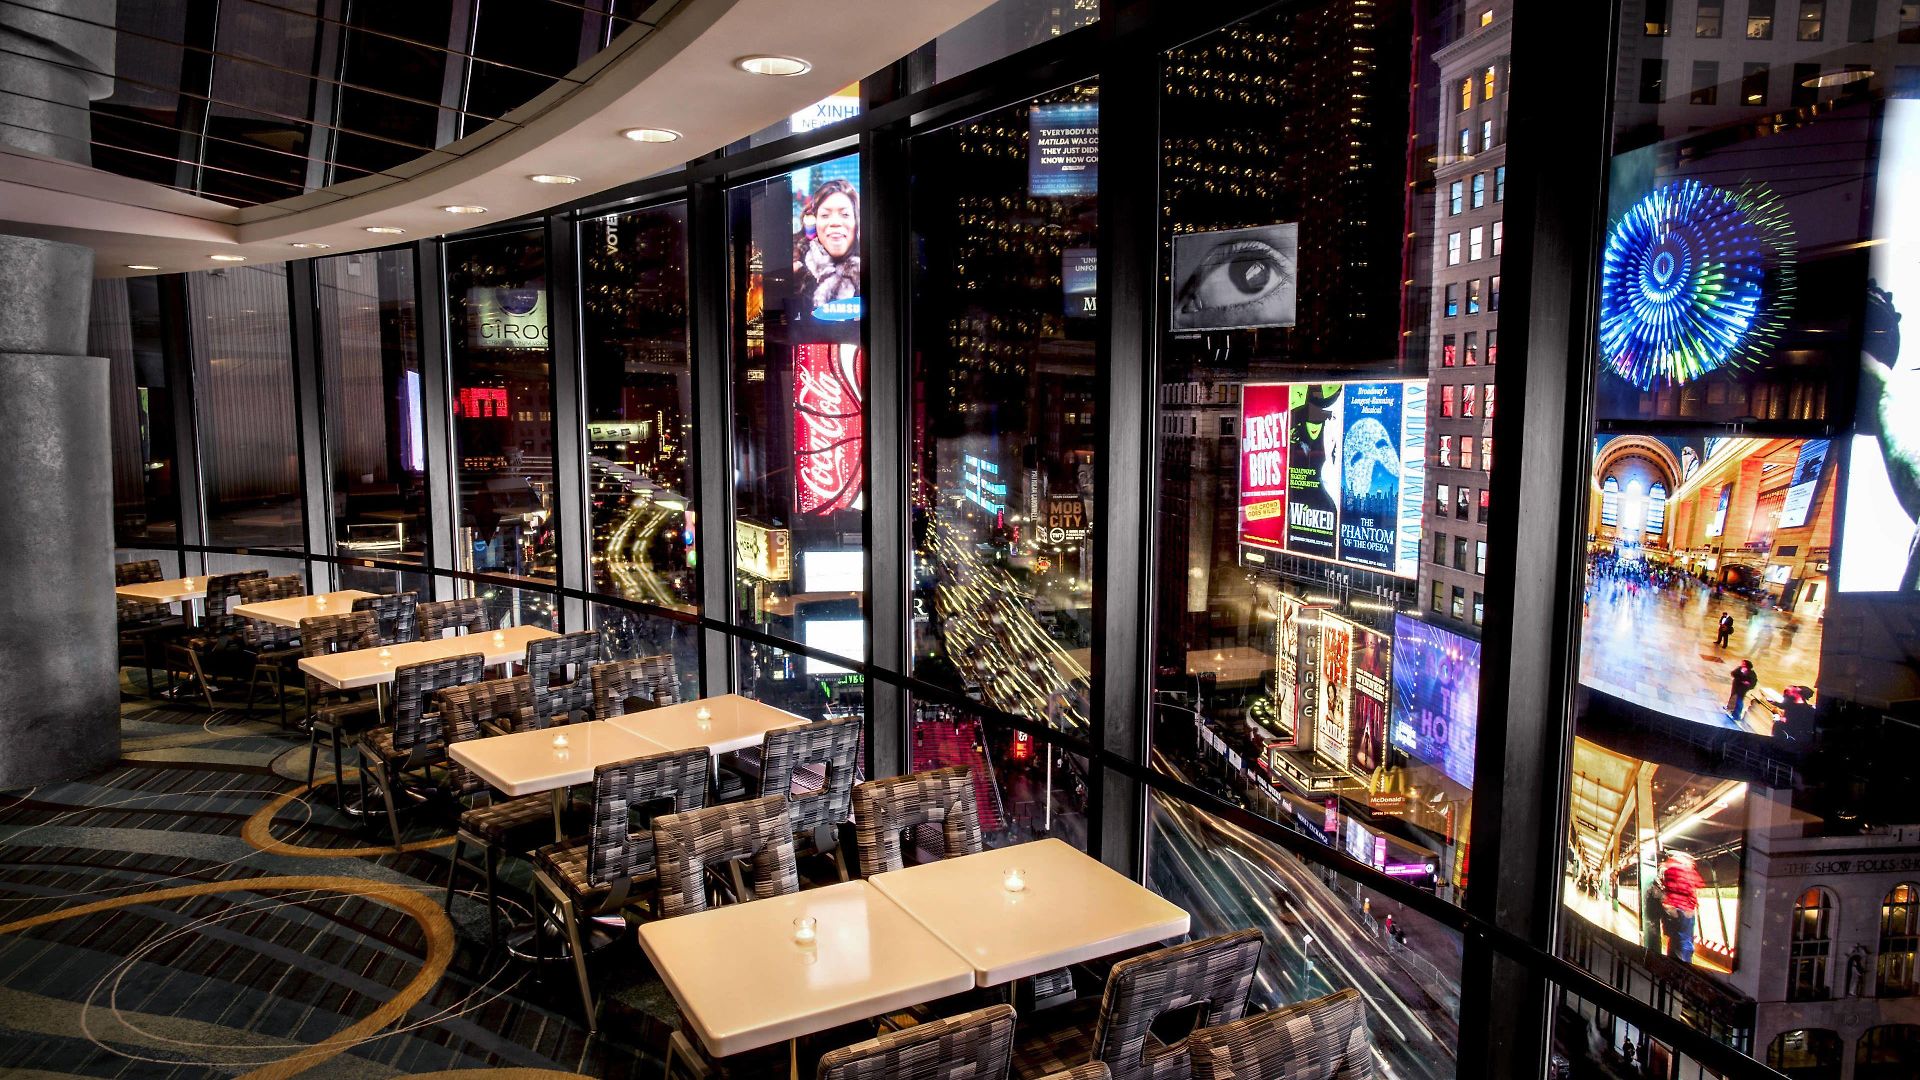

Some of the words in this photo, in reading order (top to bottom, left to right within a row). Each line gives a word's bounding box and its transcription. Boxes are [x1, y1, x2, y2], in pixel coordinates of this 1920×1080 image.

[817, 104, 859, 118] XINH
[1038, 138, 1070, 146] MATILDA
[1062, 147, 1080, 155] JUST
[822, 303, 860, 313] SAMSU
[1243, 411, 1287, 452] JERSEY
[1249, 450, 1281, 487] BOYS
[1050, 501, 1081, 514] MOB
[1050, 515, 1082, 527] CITY
[1361, 517, 1374, 527] THE
[1341, 524, 1395, 545] PHANTOM
[1344, 538, 1352, 547] OF
[1353, 539, 1366, 548] THE
[1367, 542, 1389, 553] OPERA
[1788, 863, 1811, 873] THE
[1814, 861, 1851, 873] SHOW
[1857, 859, 1895, 872] FOLKS
